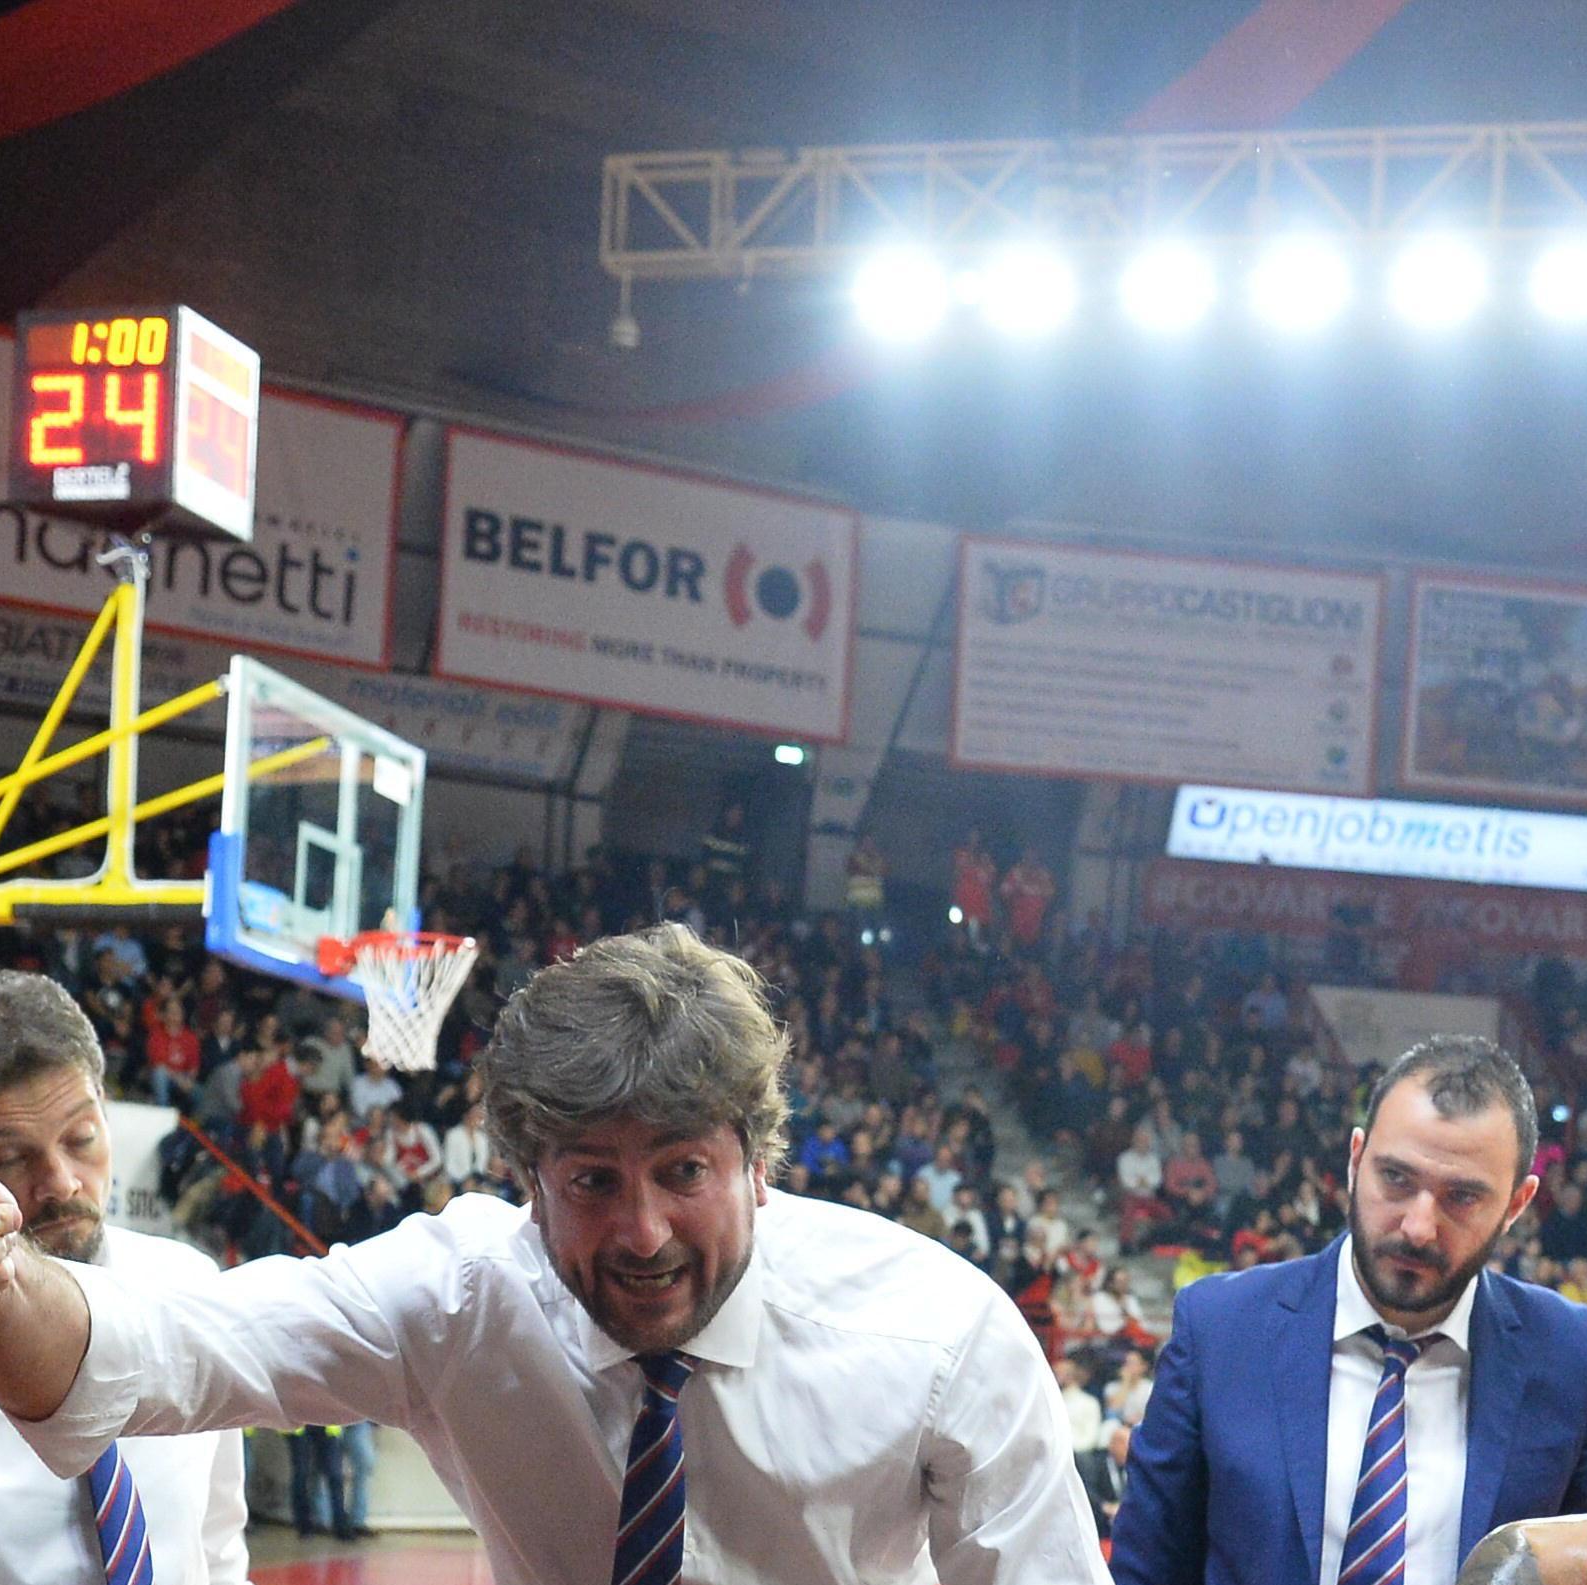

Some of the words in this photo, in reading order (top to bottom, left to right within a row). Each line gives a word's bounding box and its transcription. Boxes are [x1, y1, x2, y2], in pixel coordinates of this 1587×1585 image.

[71, 317, 169, 367] 1:00
[28, 372, 160, 466] 24
[463, 508, 707, 604] BELFOR
[456, 611, 587, 652] RESTORING
[591, 637, 655, 665] MORE
[661, 645, 717, 674] THAN
[720, 657, 829, 693] PROPERTY
